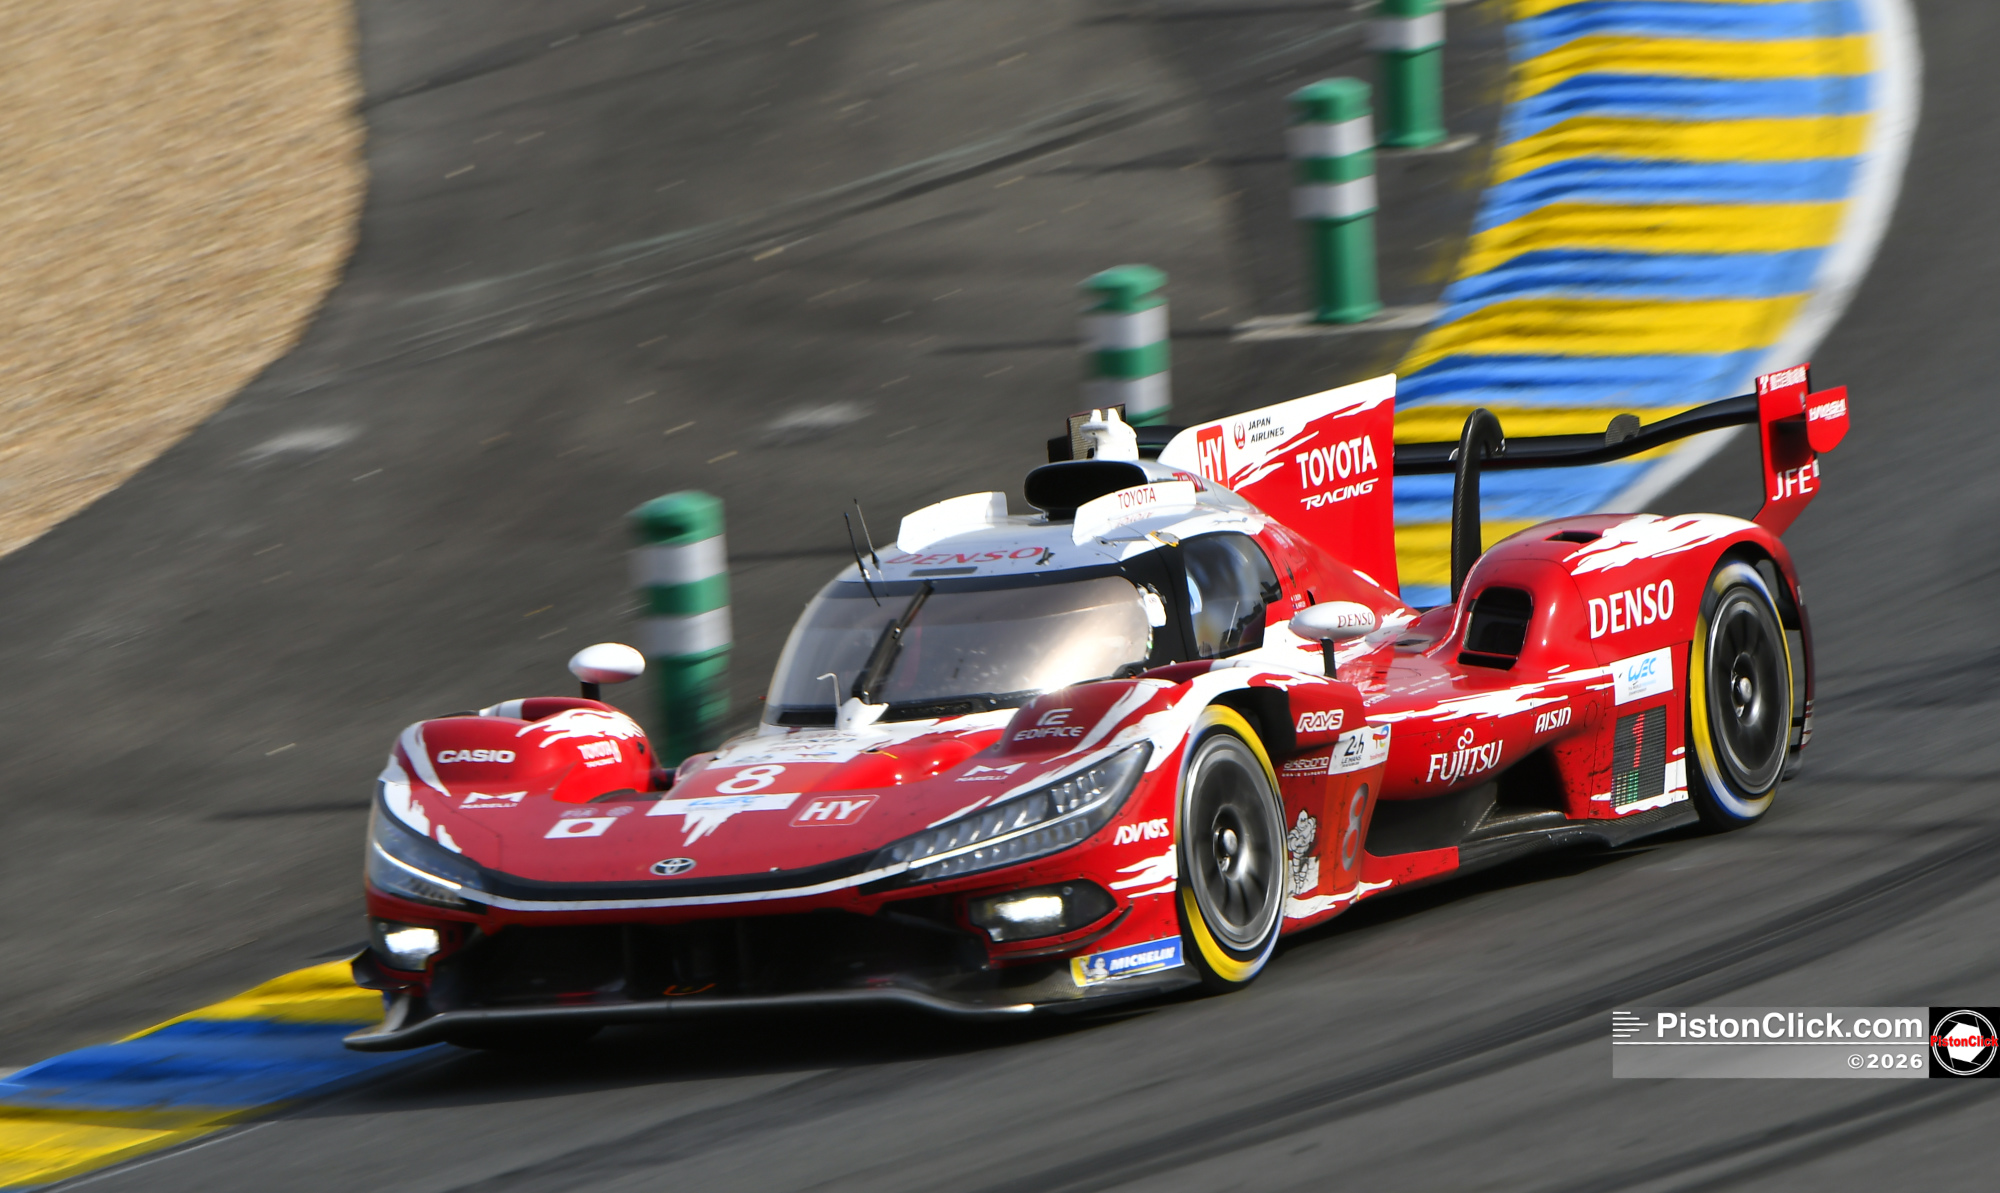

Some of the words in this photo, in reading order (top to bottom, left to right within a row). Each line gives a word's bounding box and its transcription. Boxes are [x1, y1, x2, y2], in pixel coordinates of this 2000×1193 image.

[1248, 416, 1271, 431] JAPAN
[1250, 426, 1285, 443] AIRLINES
[1198, 436, 1223, 482] HY
[1296, 434, 1378, 489] TOYOTA
[1300, 477, 1379, 510] RACING
[1772, 464, 1813, 501] JFE
[1117, 487, 1157, 509] TOYOTA
[884, 546, 1044, 565] DENSO
[1338, 611, 1374, 628] DENSO
[1588, 578, 1675, 640] DENSO
[1628, 657, 1656, 682] WEC
[1297, 710, 1343, 732] RAYS
[1535, 706, 1572, 734] AISIN
[1013, 726, 1085, 741] EDIFICE
[437, 749, 517, 764] CASIO
[1426, 737, 1504, 786] FUJITSU
[715, 764, 786, 794] 8
[798, 800, 871, 821] HY
[1342, 782, 1369, 871] 8
[1109, 946, 1176, 971] MICHELIN
